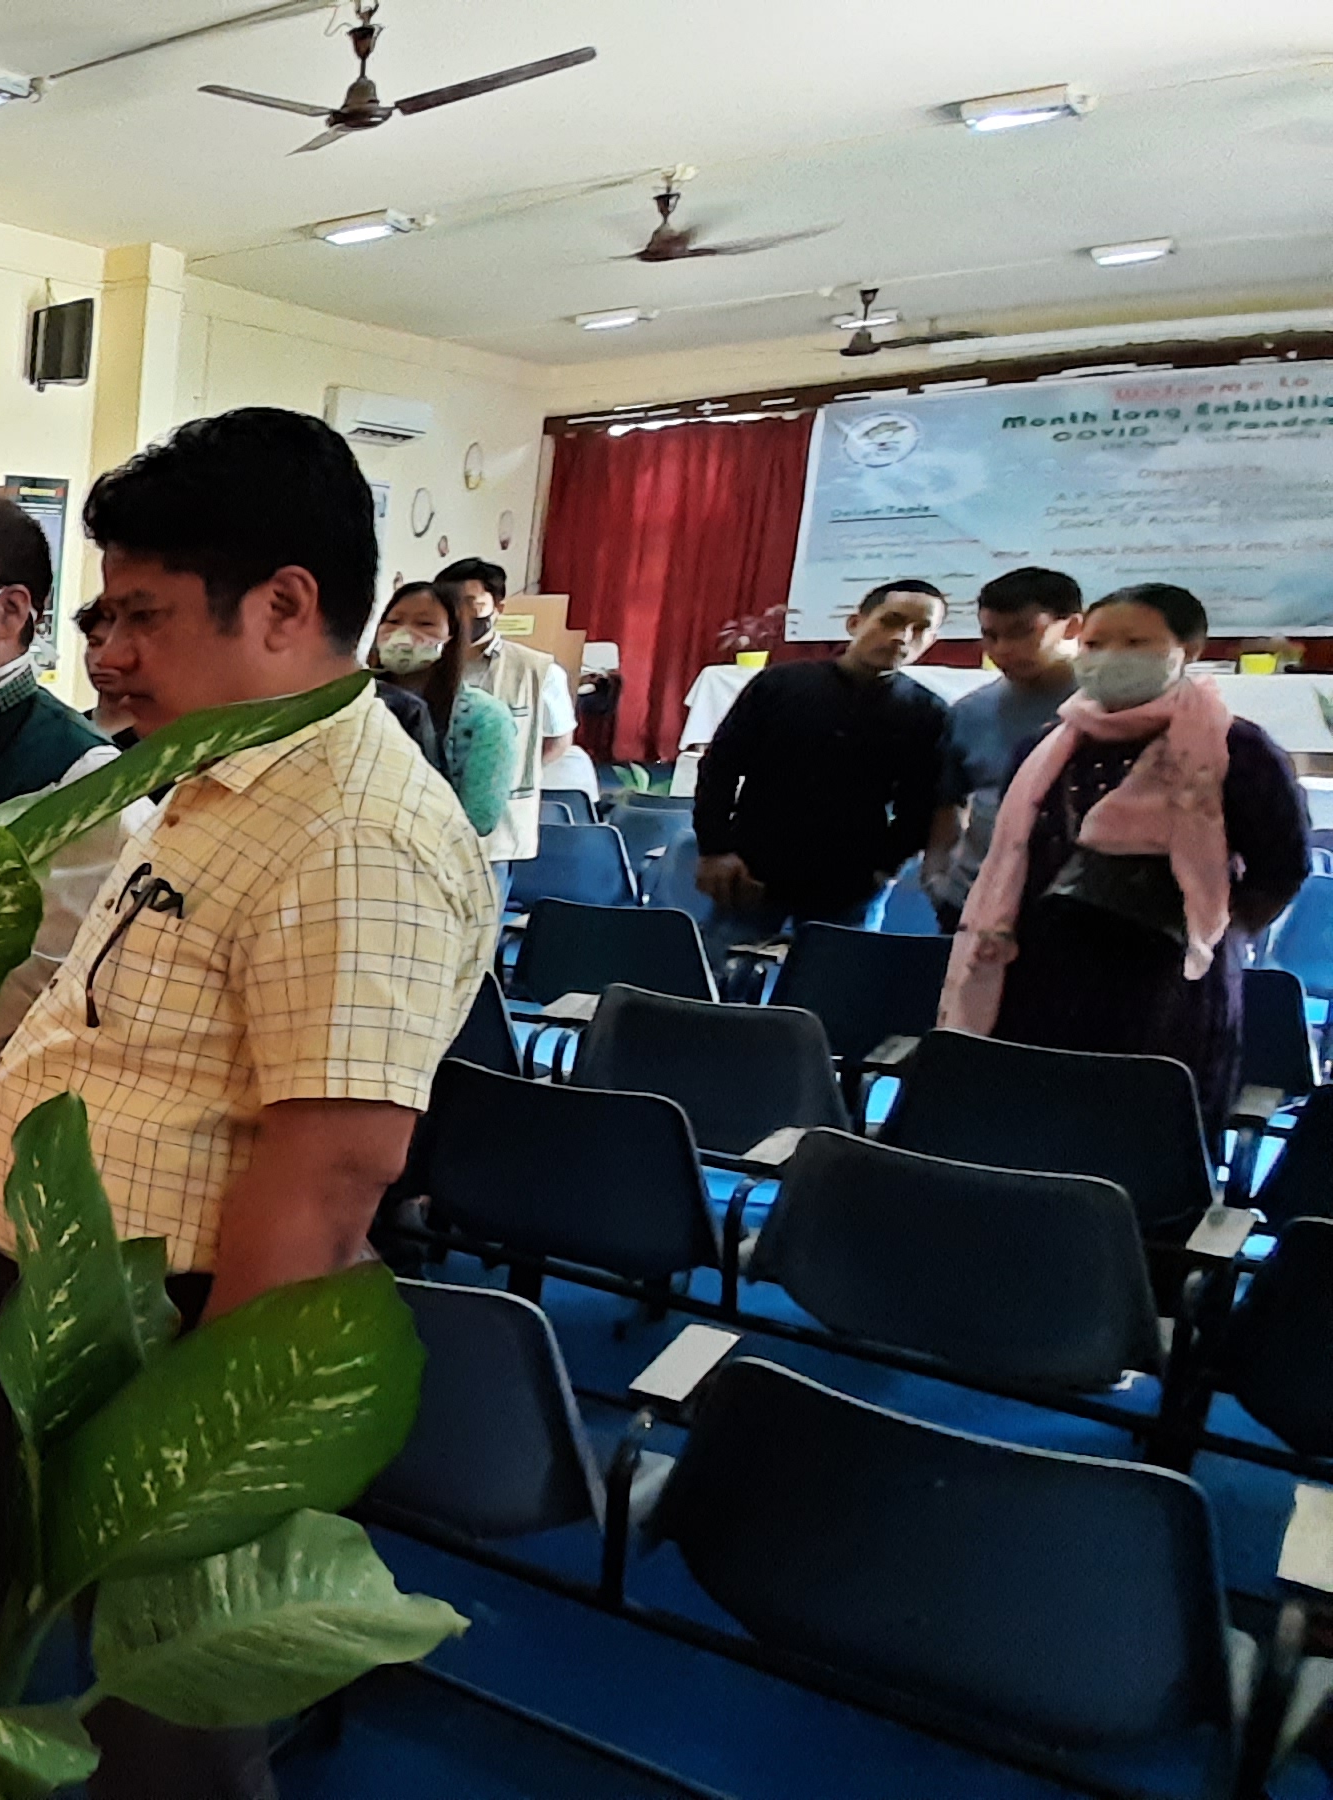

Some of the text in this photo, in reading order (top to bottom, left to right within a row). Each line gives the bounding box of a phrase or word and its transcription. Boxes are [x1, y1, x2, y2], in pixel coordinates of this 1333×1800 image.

[1001, 411, 1098, 429] Month
[1111, 408, 1182, 423] Long
[1052, 425, 1150, 443] COVID
